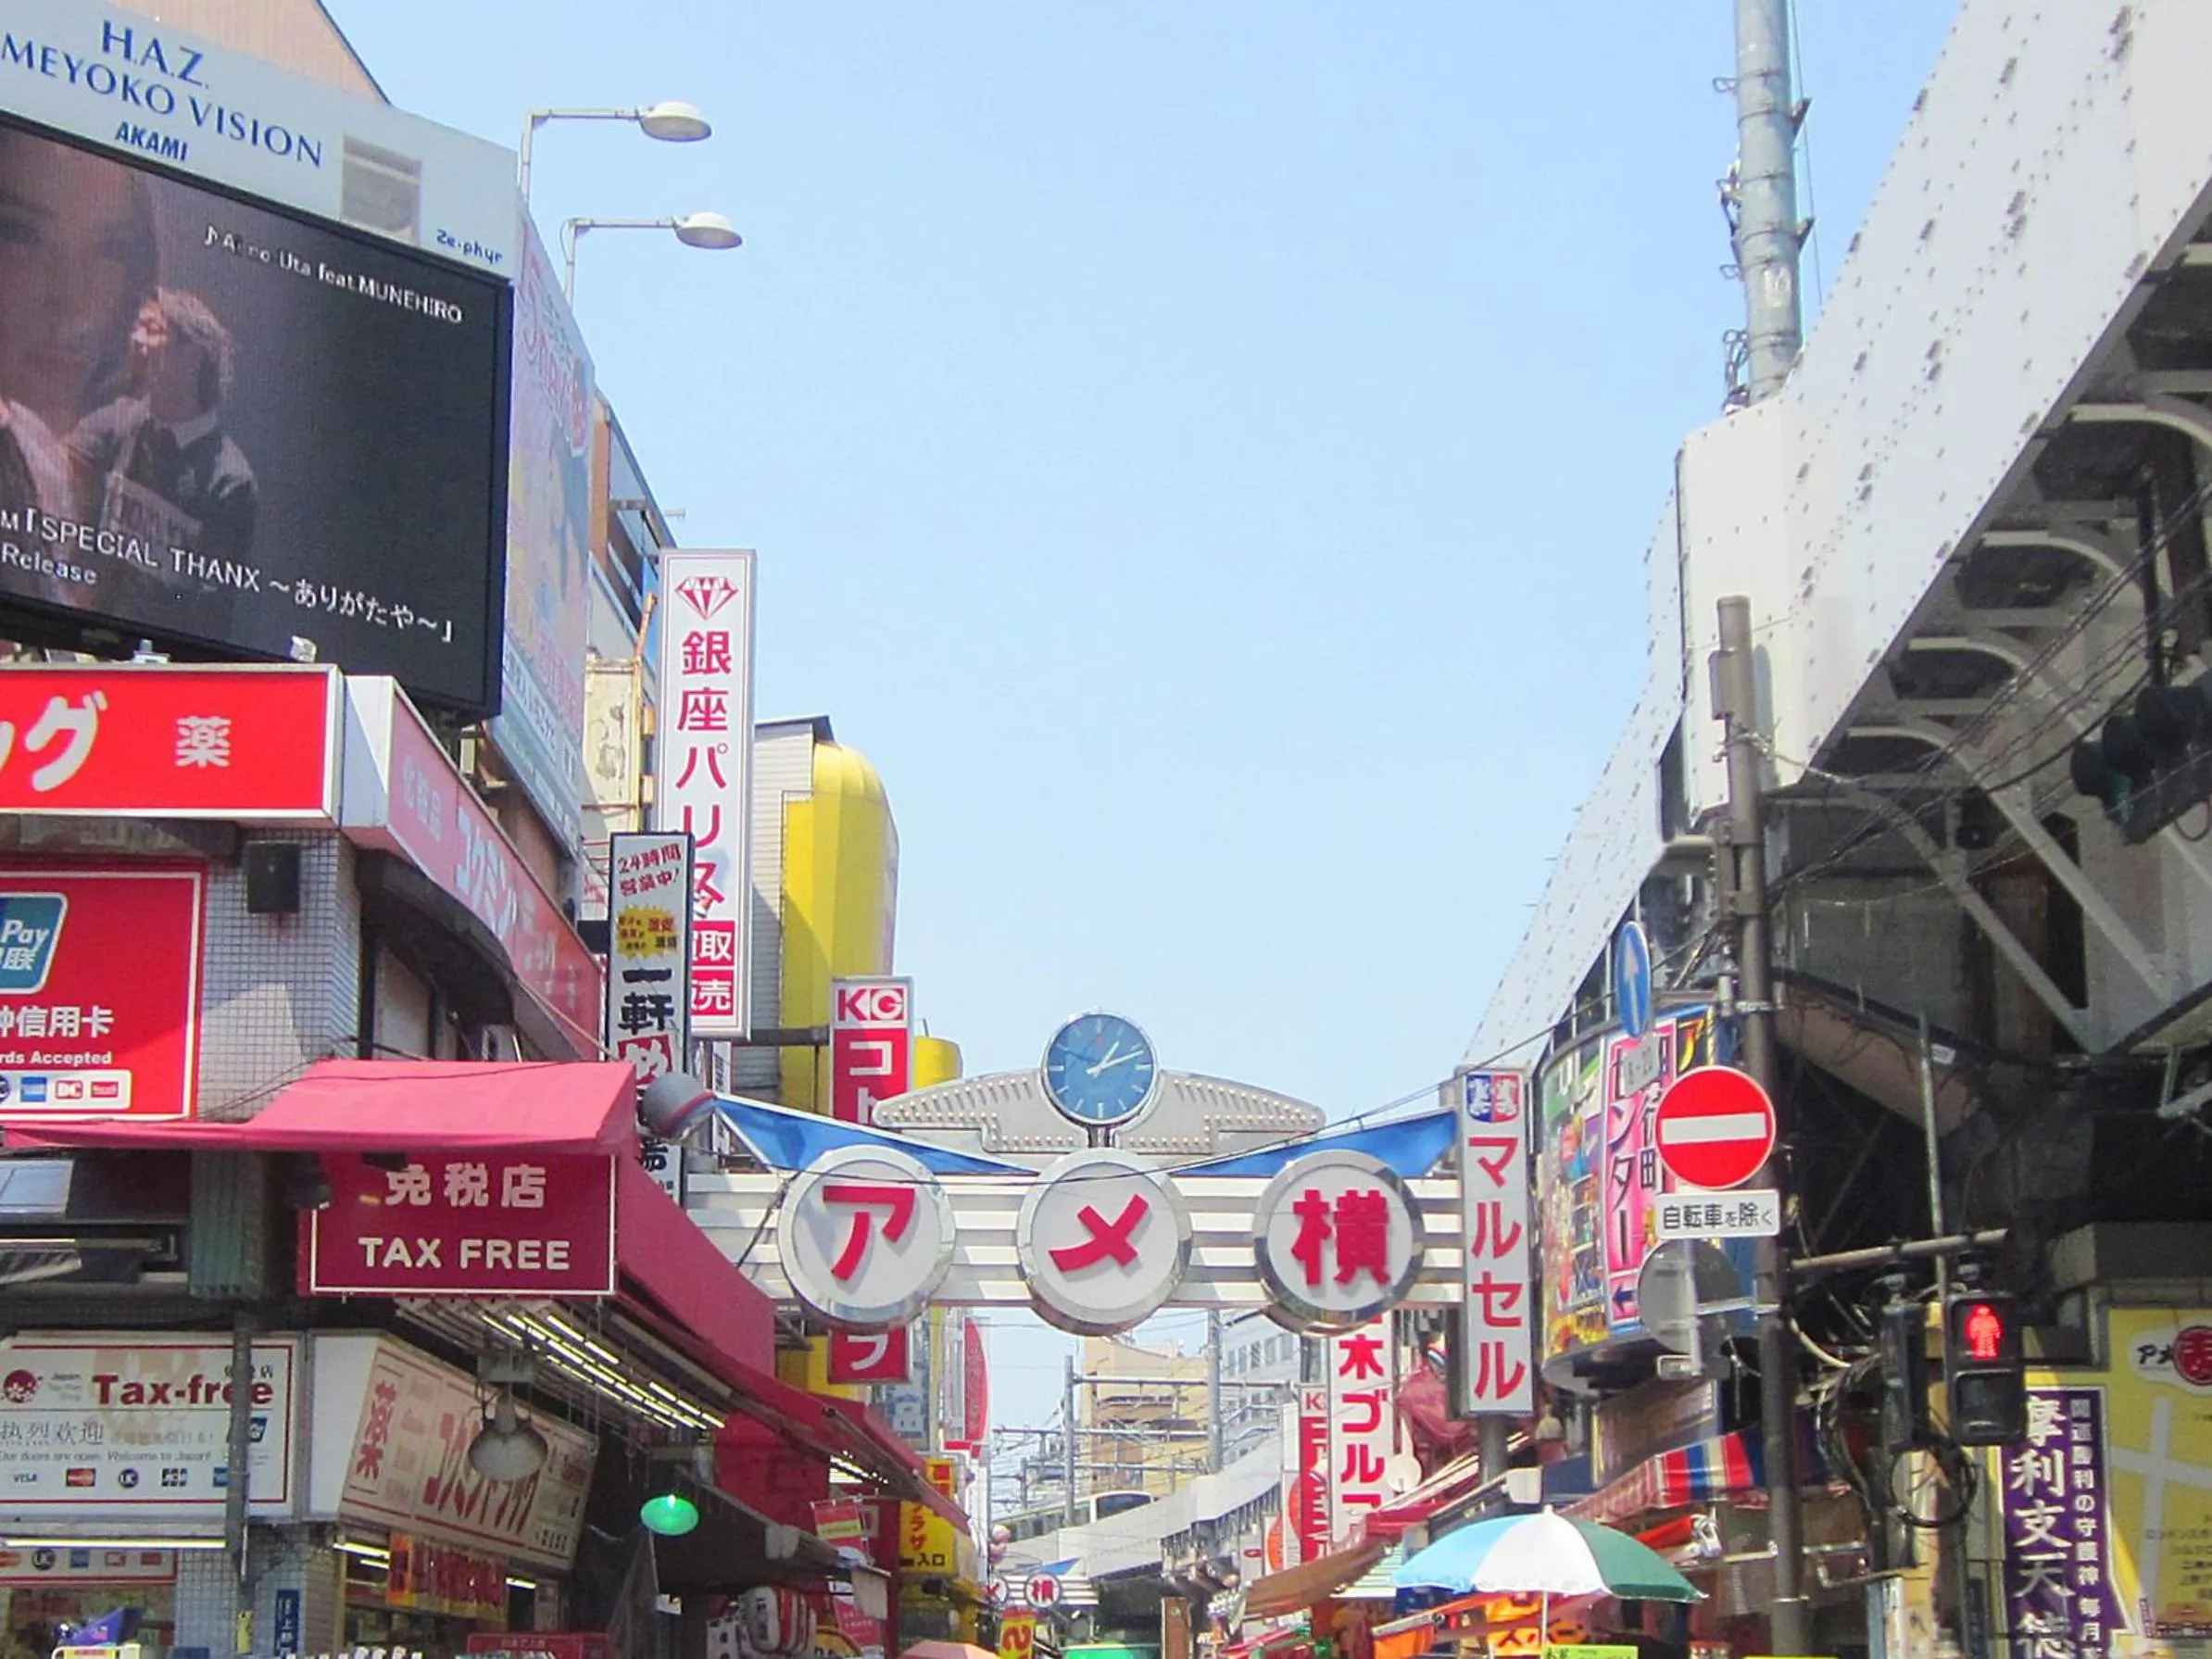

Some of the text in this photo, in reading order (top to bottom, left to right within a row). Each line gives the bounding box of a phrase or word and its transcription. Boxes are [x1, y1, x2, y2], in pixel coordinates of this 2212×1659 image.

[115, 121, 188, 161] AKAMI
[190, 95, 322, 169] VISION
[279, 249, 312, 277] Uta
[170, 547, 260, 593] THANX
[176, 715, 232, 767] 薬
[675, 631, 732, 904] 銀座パリス
[618, 843, 681, 873] 24時間
[0, 948, 35, 971] 联
[691, 930, 732, 1011] 取 売
[30, 1051, 112, 1066] Accepted
[385, 1163, 547, 1207] 免税店
[1663, 1203, 1772, 1229] 自転車を除く
[358, 1238, 570, 1270] TAX FREE
[1469, 1137, 1527, 1400] マルセル
[1306, 1392, 1326, 1411] K
[1338, 1315, 1388, 1509] 木ブル
[917, 1552, 945, 1566] 入口
